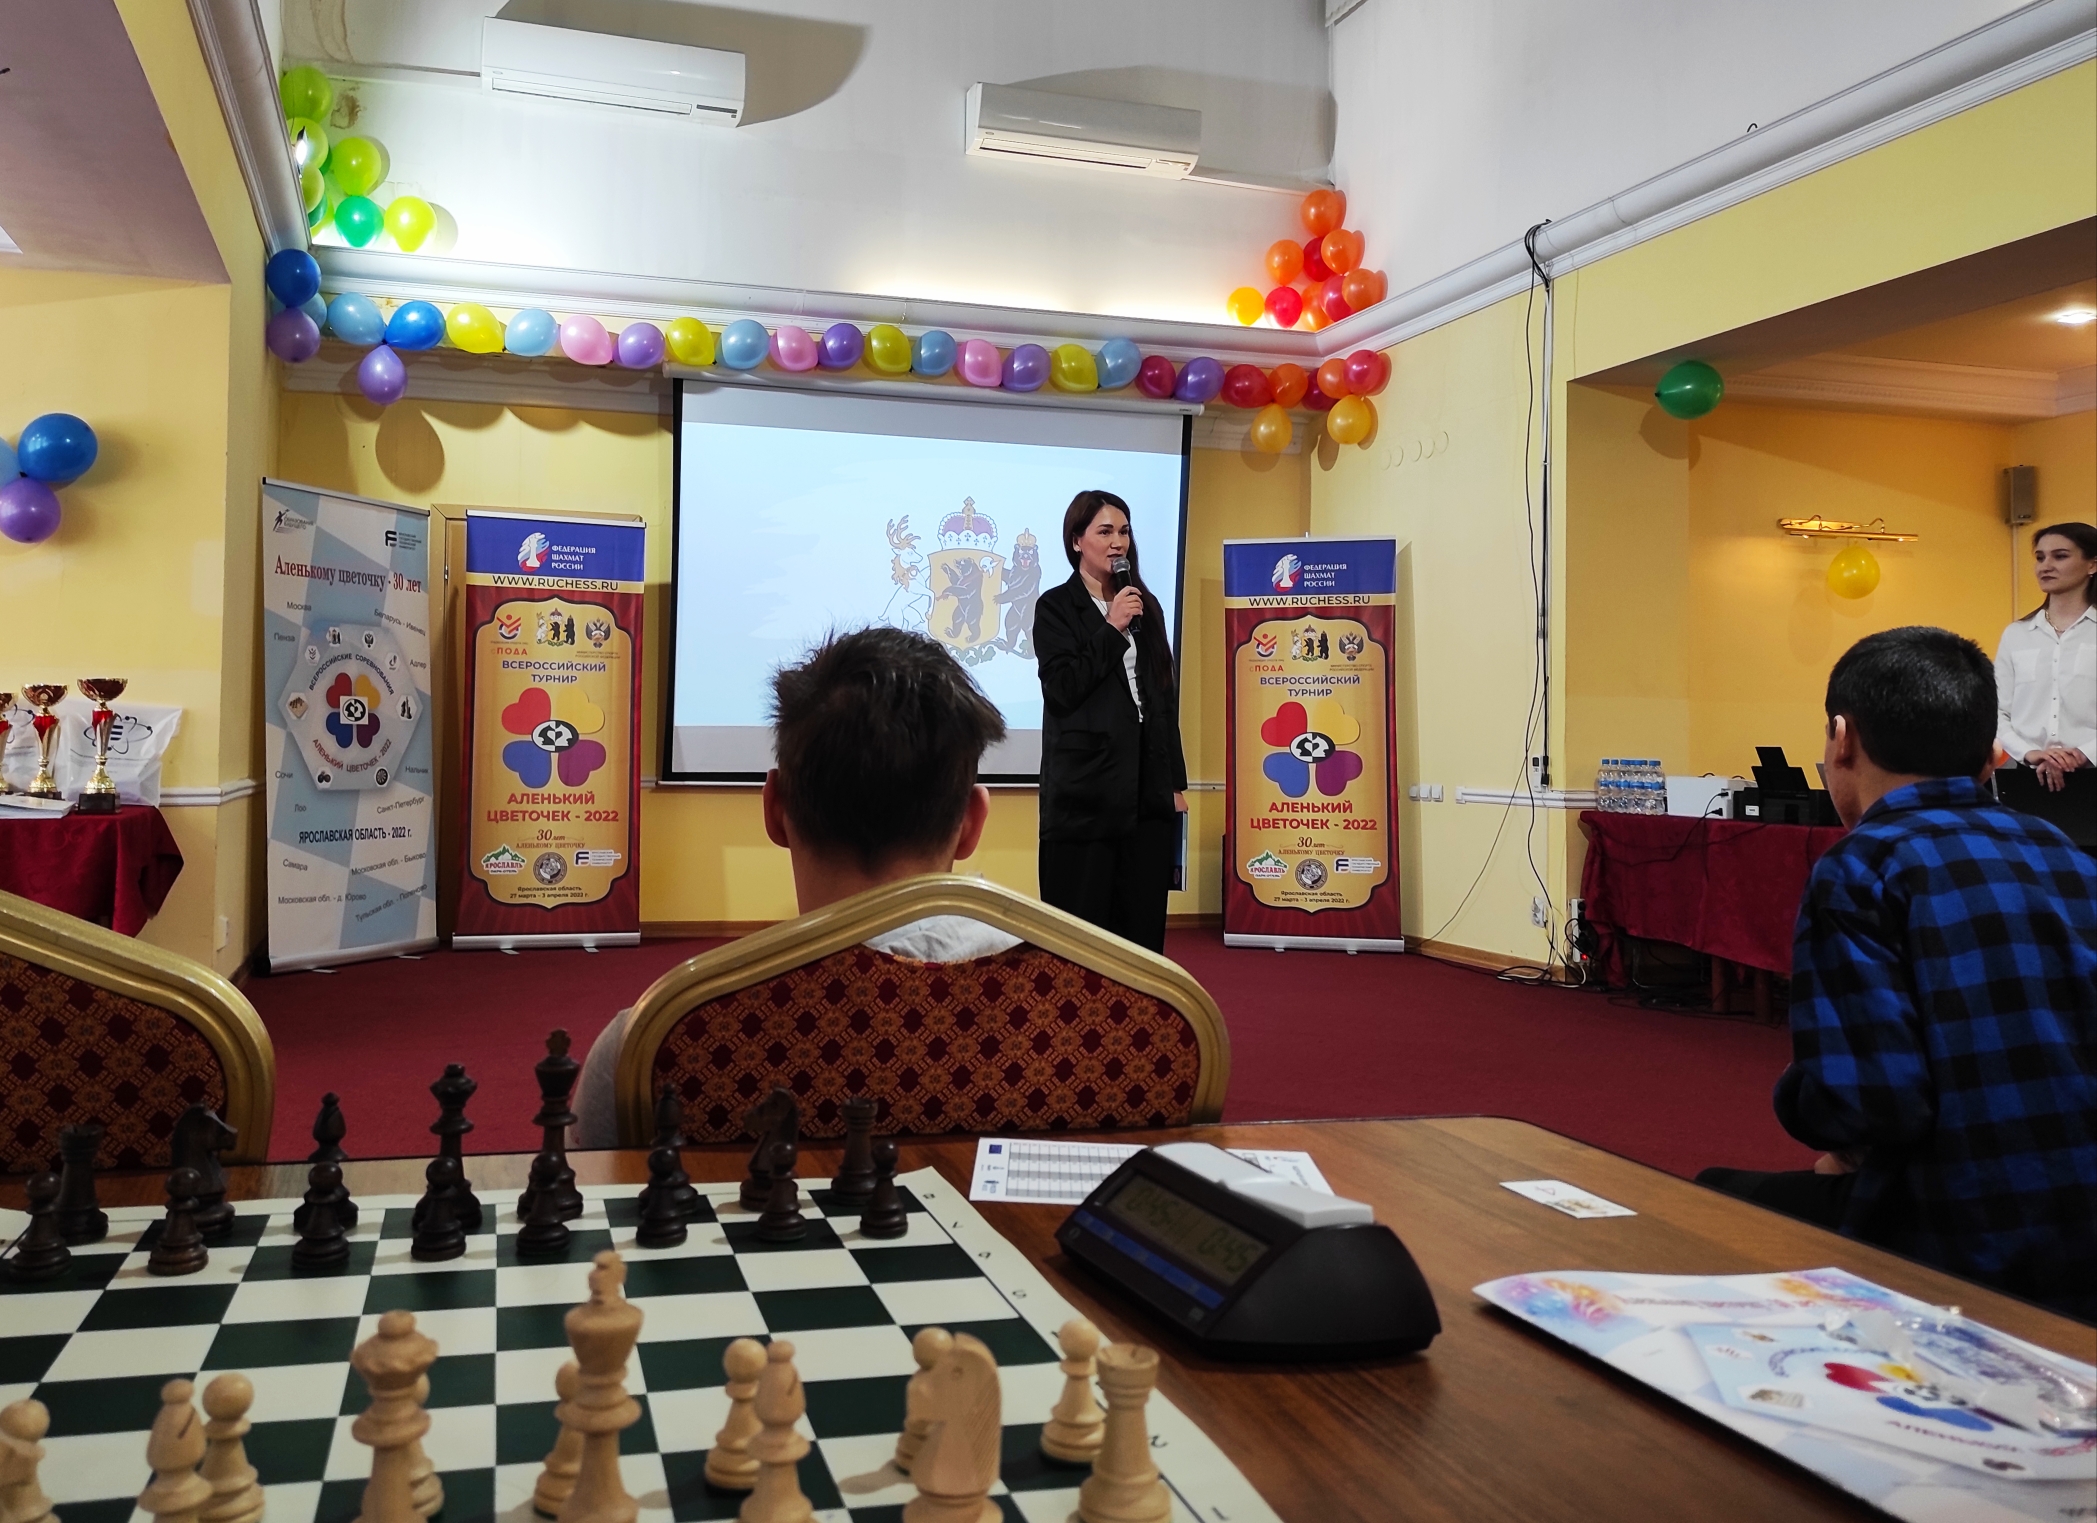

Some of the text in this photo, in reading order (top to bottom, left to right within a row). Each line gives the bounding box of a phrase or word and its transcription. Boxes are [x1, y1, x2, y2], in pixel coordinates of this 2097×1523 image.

[552, 545, 596, 554] ФЕДЕРАЦИЯ
[552, 562, 583, 570] РОССИИ
[275, 555, 336, 586] Аленькому
[339, 571, 386, 592] цветочку
[393, 572, 403, 591] 30
[406, 579, 421, 593] лет
[492, 575, 618, 591] WWW.RUCHESS.RU
[287, 602, 311, 611] Москва
[1249, 595, 1370, 606] WWW.RUCHESS.RU
[374, 608, 402, 625] Беларусь
[502, 660, 606, 672] ВСЕРОССИЙСКИЙ
[309, 653, 394, 695] ВСЕРОССИЙСКИЕ СОРЕВНОВАНИЯ
[531, 674, 577, 684] ТУРНИР
[1260, 674, 1360, 685] ВСЕРОССИЙСКИЙ
[1288, 689, 1332, 697] ТУРНИР
[313, 739, 343, 771] АЛЕНЬКИЙ
[346, 755, 378, 772] ЦВЕТОЧЕК
[380, 739, 392, 756] 2022
[507, 791, 594, 805] АЛЕНЬКИЙ
[377, 796, 424, 814] Санкт-Петербург
[1269, 800, 1353, 813] АЛЕНЬКИЙ
[487, 810, 571, 823] ЦВЕТОЧЕК
[584, 810, 619, 822] 2022
[1250, 818, 1330, 830] ЦВЕТОЧЕК
[1343, 819, 1377, 830] 2022
[299, 829, 353, 844] ЯРОСЛАВСКАЯ
[355, 828, 386, 840] ОБЛАСТЬ
[392, 827, 406, 838] 2022
[408, 829, 412, 837] г.
[537, 829, 552, 841] 30
[1297, 836, 1312, 848] 30
[283, 859, 308, 871] Самара
[352, 862, 386, 876] Московская
[278, 895, 317, 904] Московская
